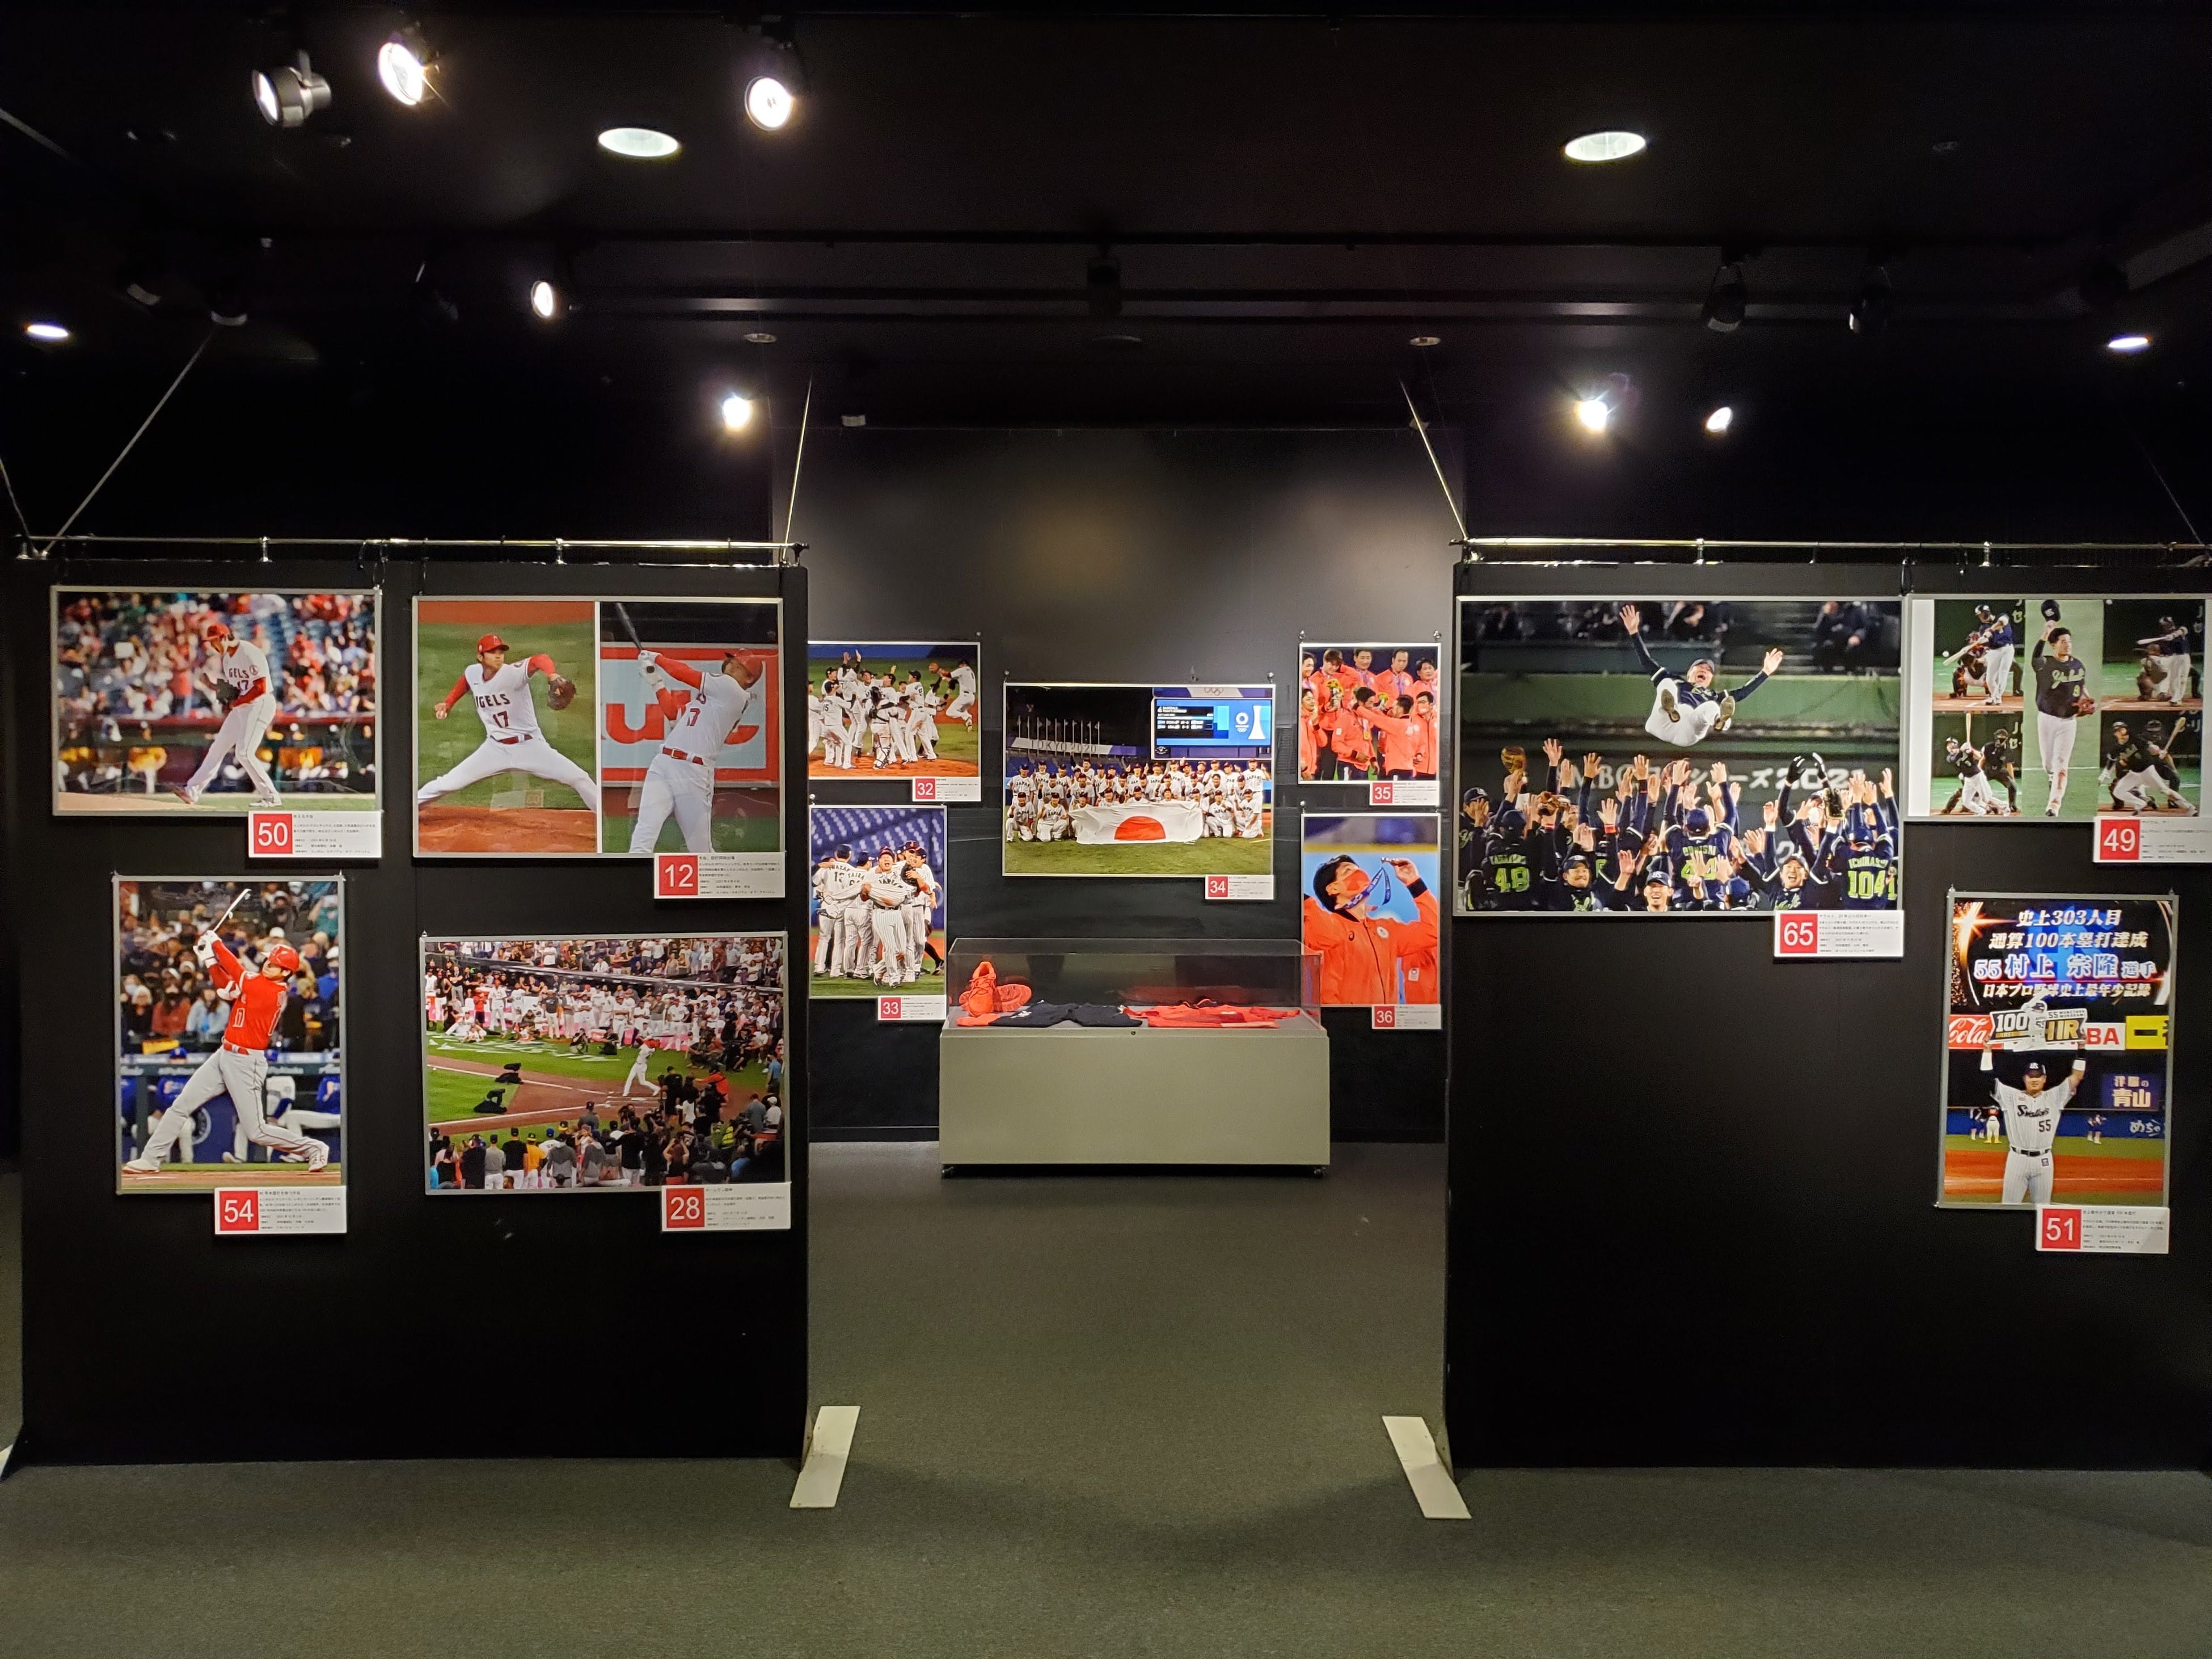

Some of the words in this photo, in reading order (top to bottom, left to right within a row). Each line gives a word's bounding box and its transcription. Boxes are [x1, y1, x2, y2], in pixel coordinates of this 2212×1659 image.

[492, 711, 509, 728] 17
[917, 783, 933, 796] 32
[1374, 787, 1391, 800] 35
[258, 822, 288, 846] 50
[2103, 829, 2135, 851] 49
[665, 864, 693, 887] 12
[1495, 867, 1530, 893] 48
[1210, 880, 1226, 894] 34
[1848, 870, 1885, 900] 104
[2016, 909, 2122, 926] 史上303人目
[1784, 922, 1813, 946] 65
[1989, 931, 2149, 949] 通算100本塁打達成
[883, 1002, 898, 1014] 33
[1377, 1011, 1392, 1023] 36
[1996, 1013, 2029, 1032] 100
[2112, 1089, 2151, 1107] 青山
[2039, 1120, 2051, 1132] 55
[224, 1199, 254, 1223] 54
[670, 1196, 700, 1220] 28
[2046, 1218, 2074, 1242] 51
